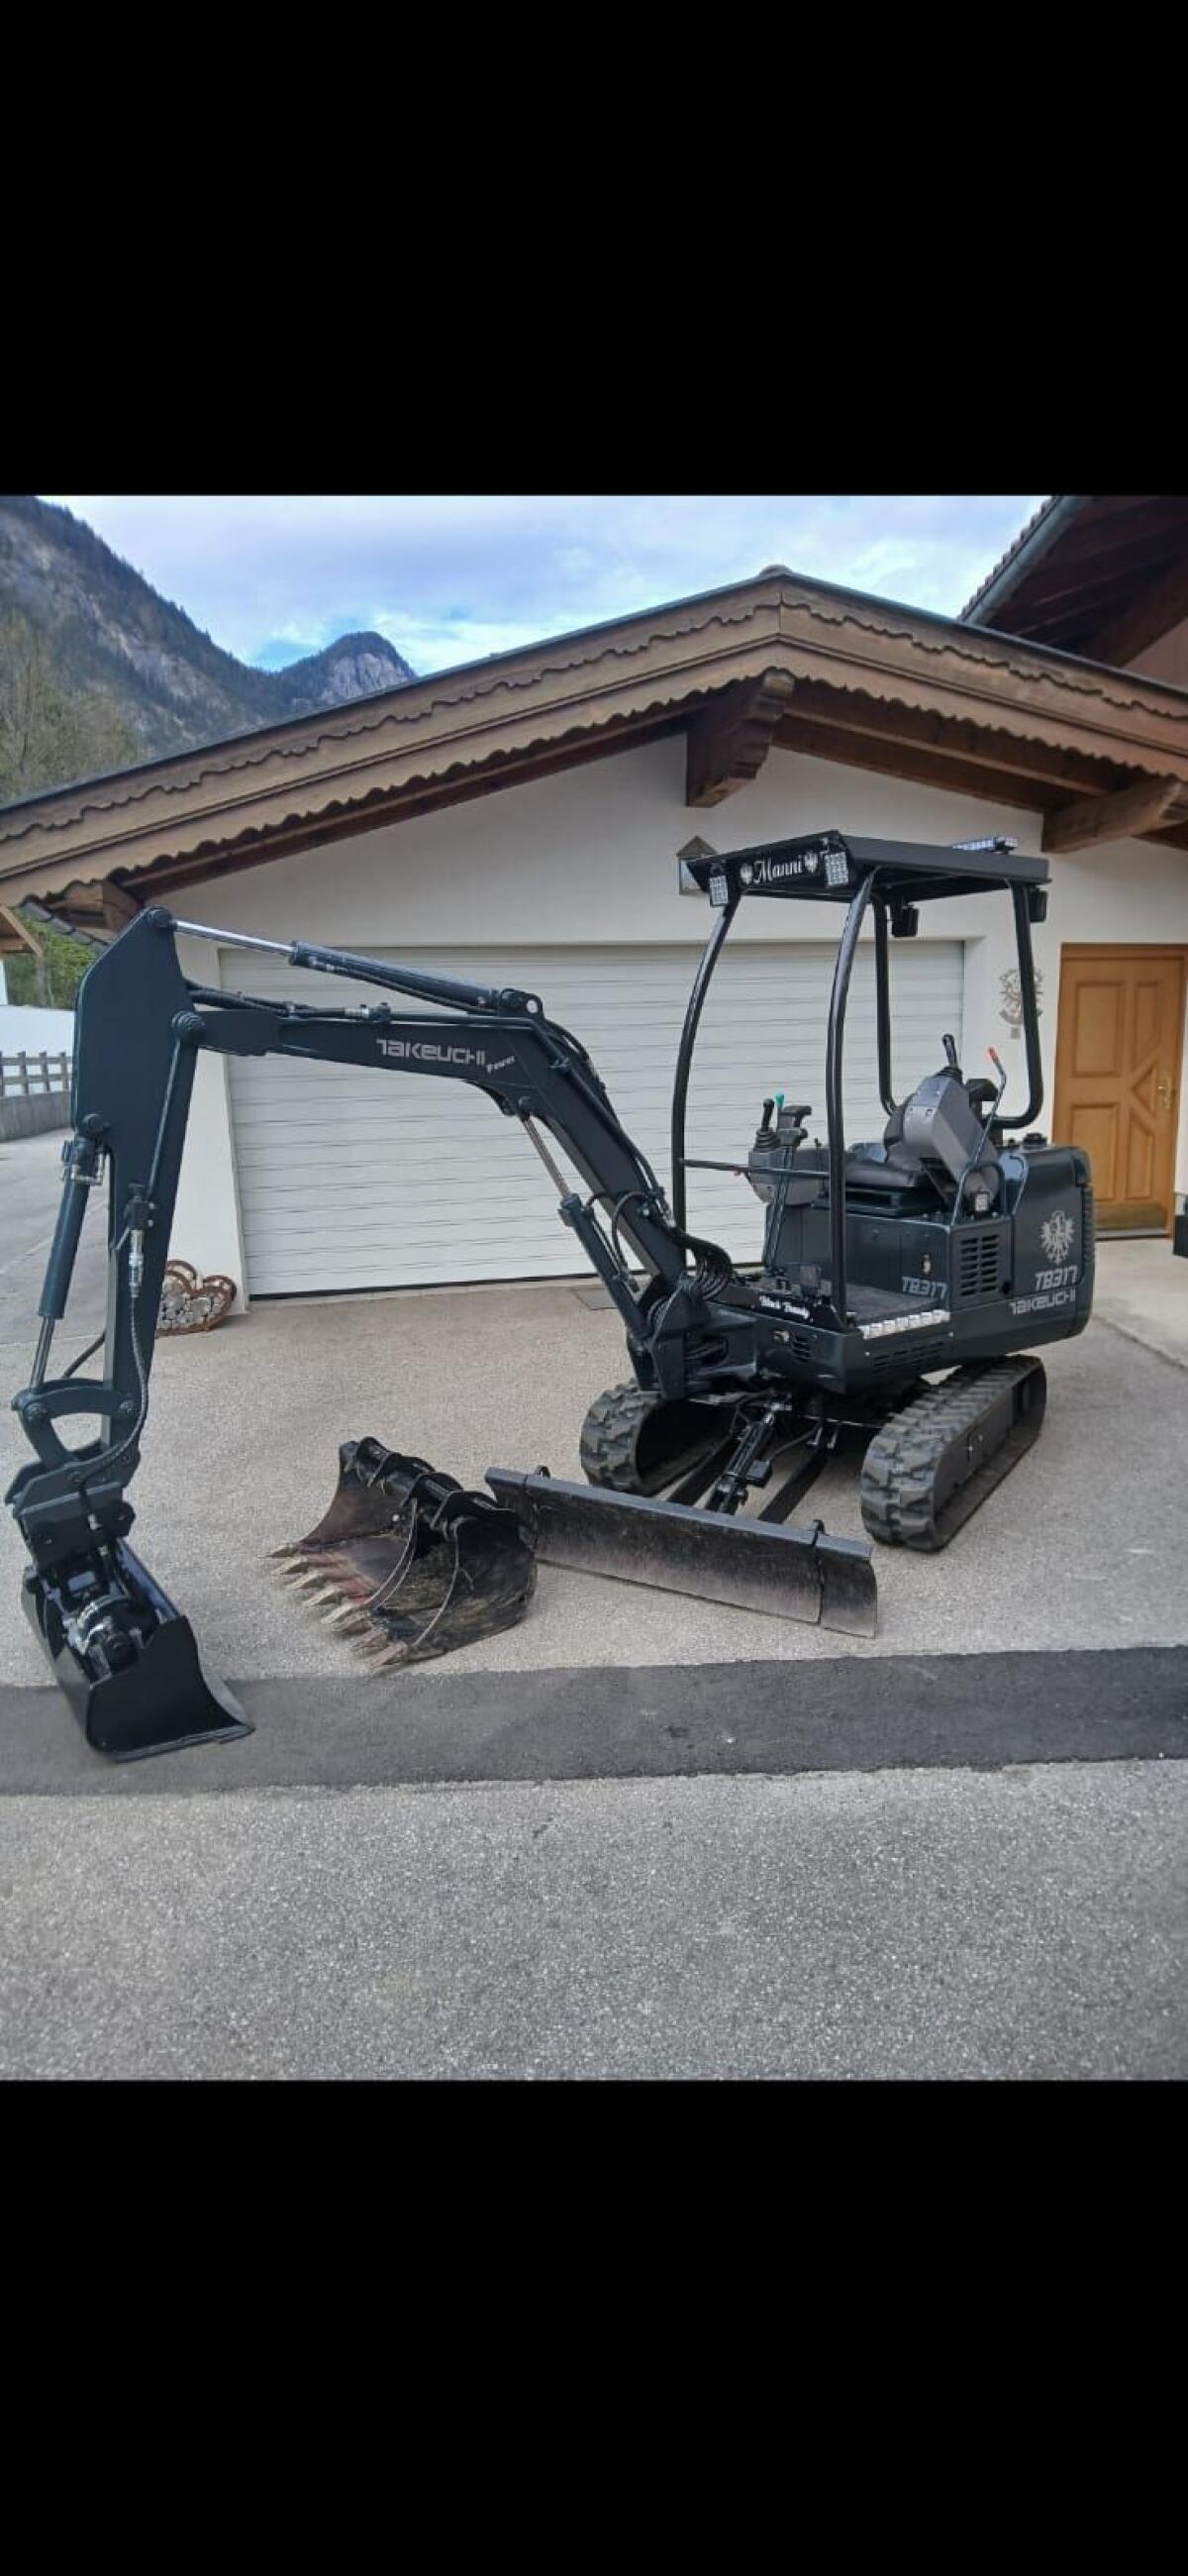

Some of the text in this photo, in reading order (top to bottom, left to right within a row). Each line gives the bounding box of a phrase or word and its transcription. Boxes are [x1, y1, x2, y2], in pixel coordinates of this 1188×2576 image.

[753, 854, 803, 884] Manni
[375, 1038, 485, 1067] TAKEUCHI
[900, 1275, 947, 1300] TB317
[1035, 1264, 1079, 1291] TB317
[1009, 1288, 1076, 1315] TAKEUCHI
